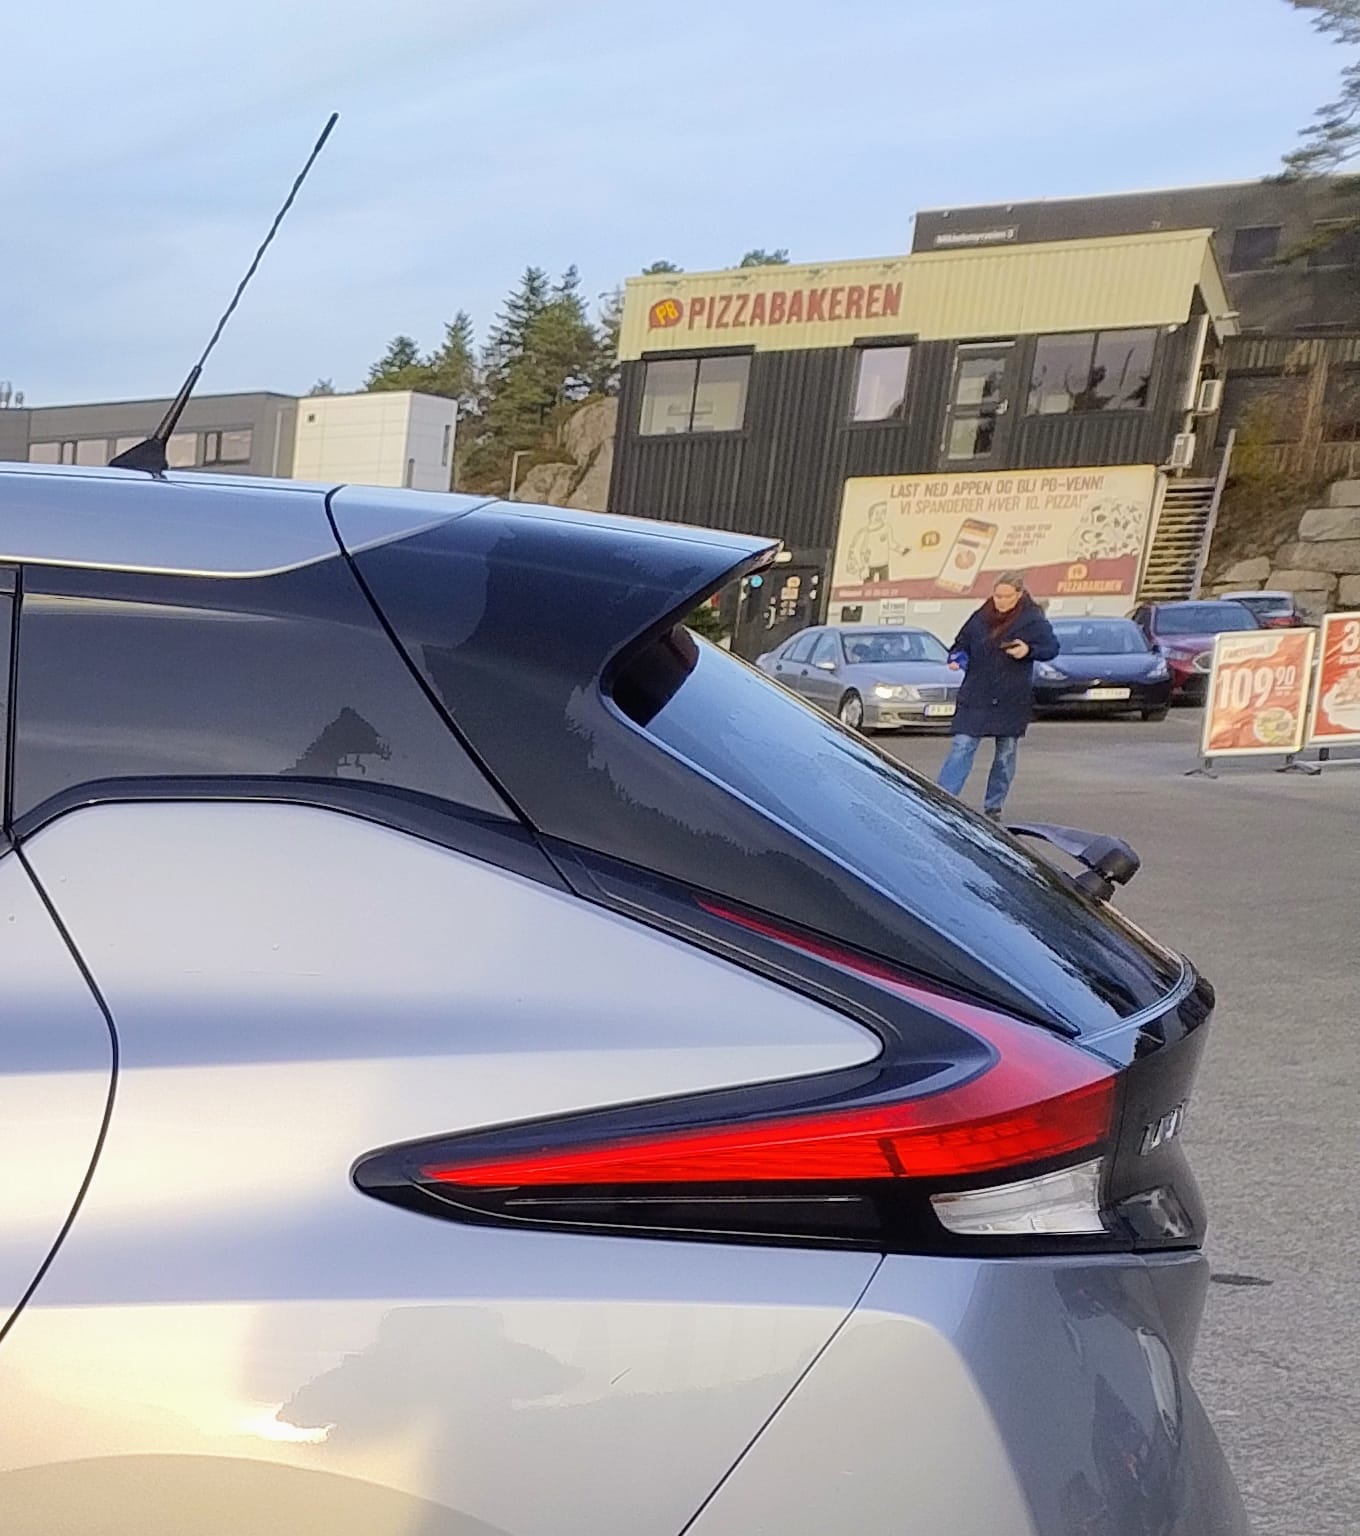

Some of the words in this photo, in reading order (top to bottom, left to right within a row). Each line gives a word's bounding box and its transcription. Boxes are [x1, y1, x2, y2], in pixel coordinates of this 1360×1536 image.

[688, 282, 903, 330] PIZZABAKEREN
[890, 483, 920, 498] LAST
[924, 482, 949, 497] NED
[952, 480, 993, 496] APPEN
[914, 498, 985, 514] SPANDERER
[987, 496, 1020, 512] HVER
